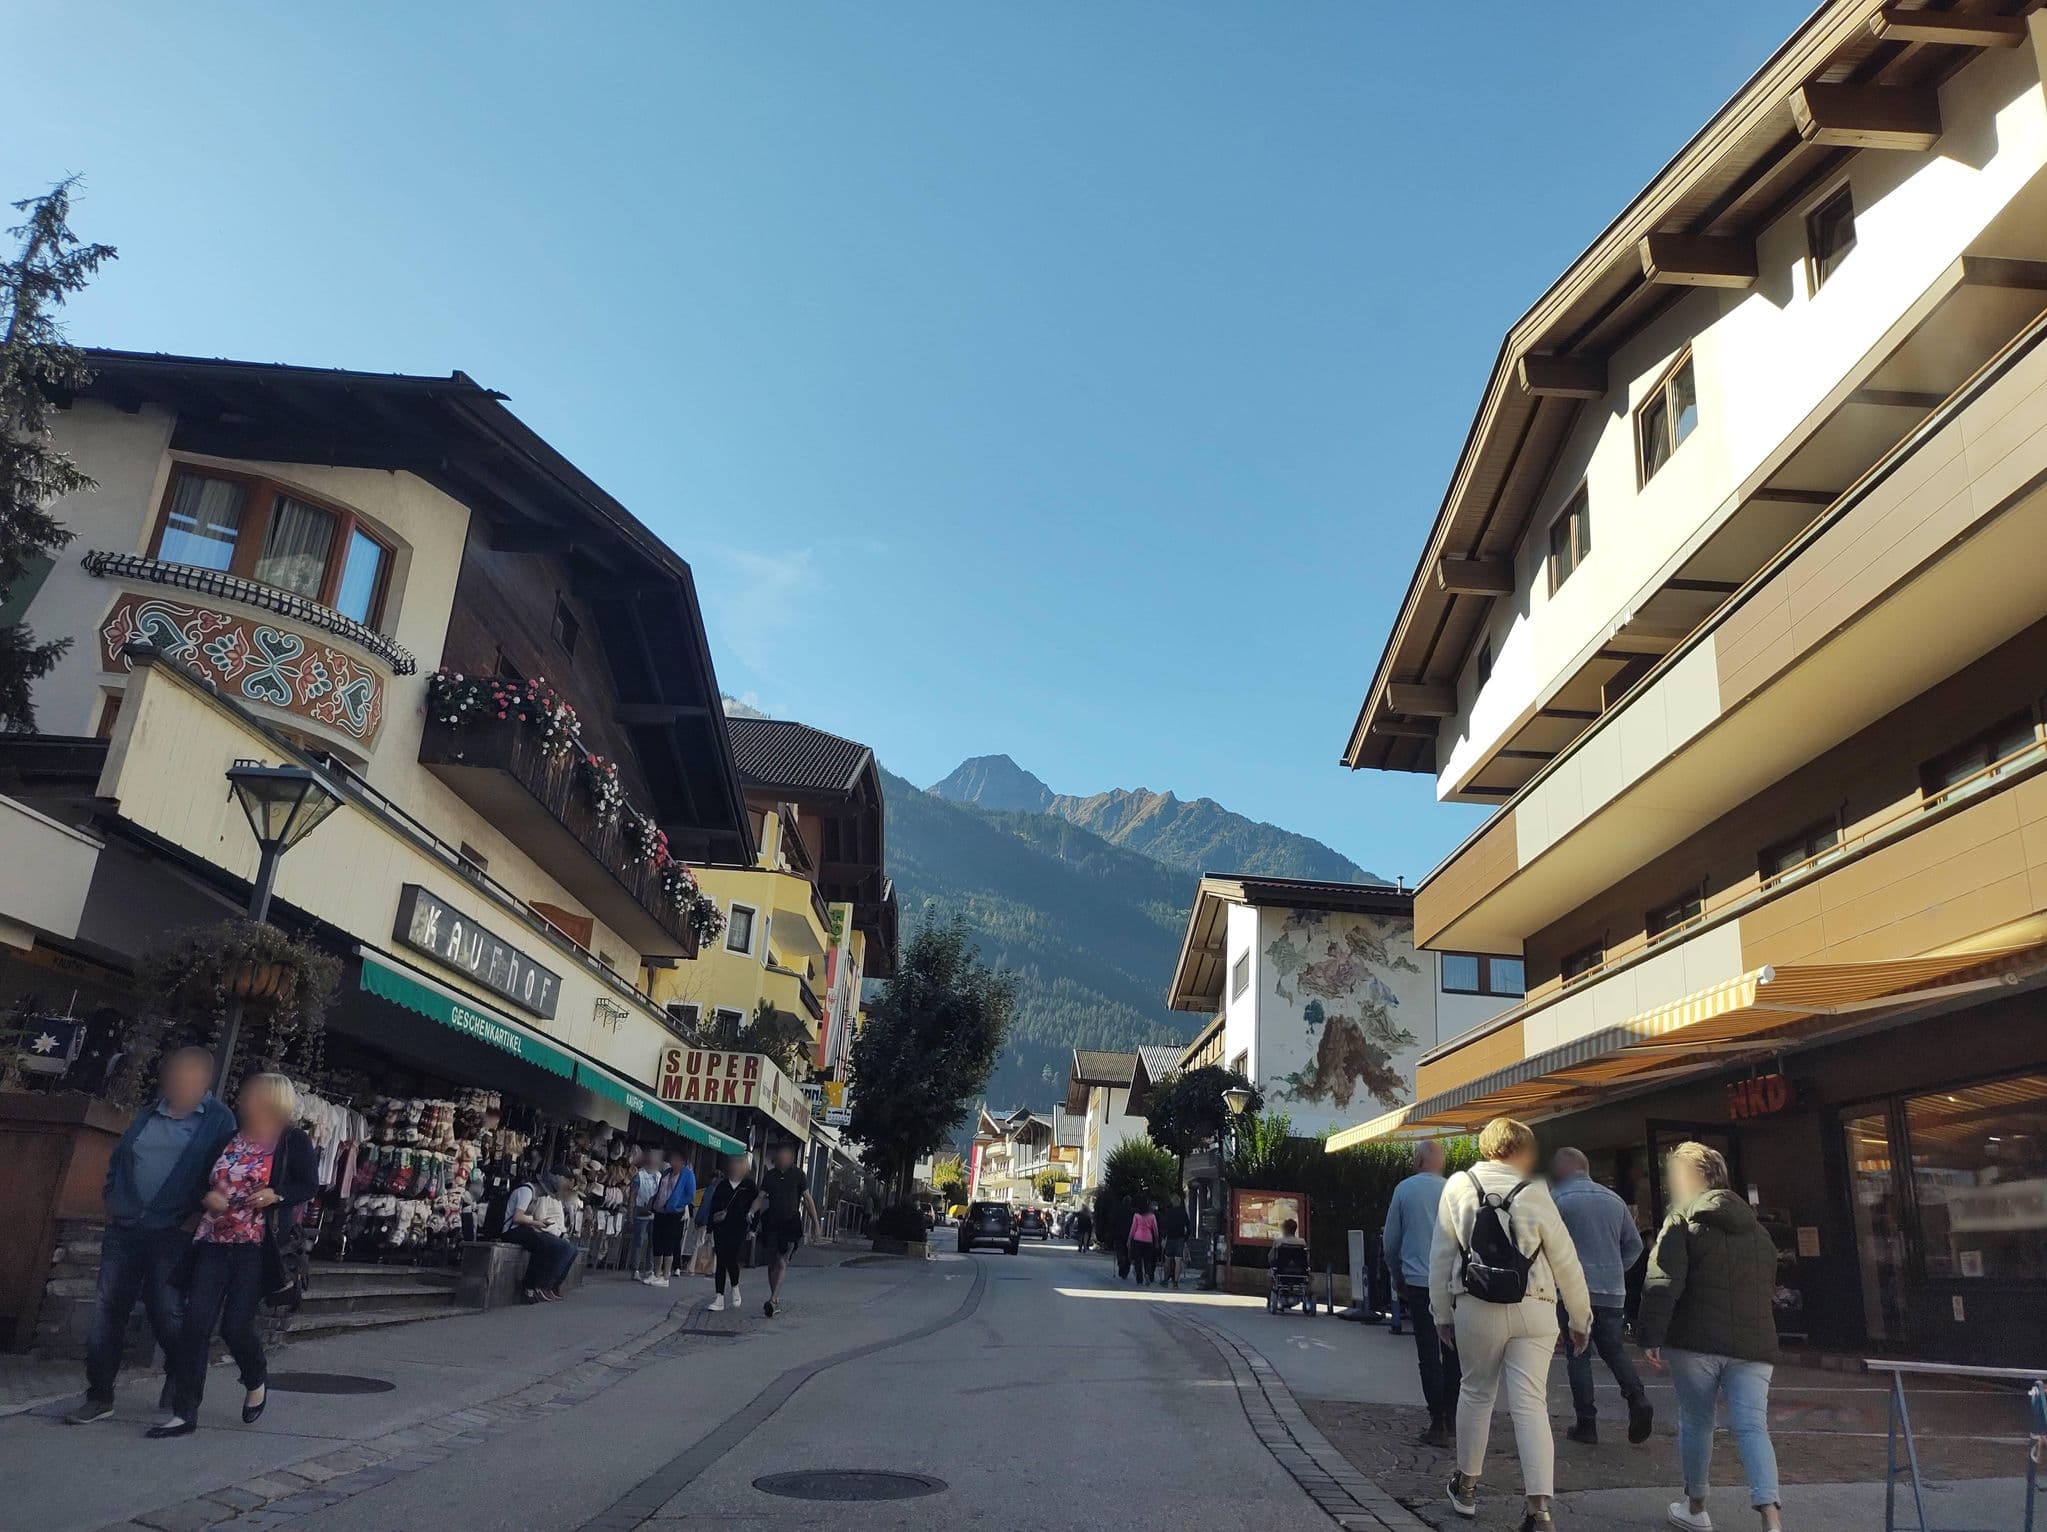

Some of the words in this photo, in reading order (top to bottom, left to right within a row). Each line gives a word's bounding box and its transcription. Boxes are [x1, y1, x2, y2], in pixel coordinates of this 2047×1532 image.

[451, 1005, 523, 1054] GESCHENKARTIKEL
[665, 1048, 760, 1080] SUPER
[661, 1074, 756, 1105] MARKT
